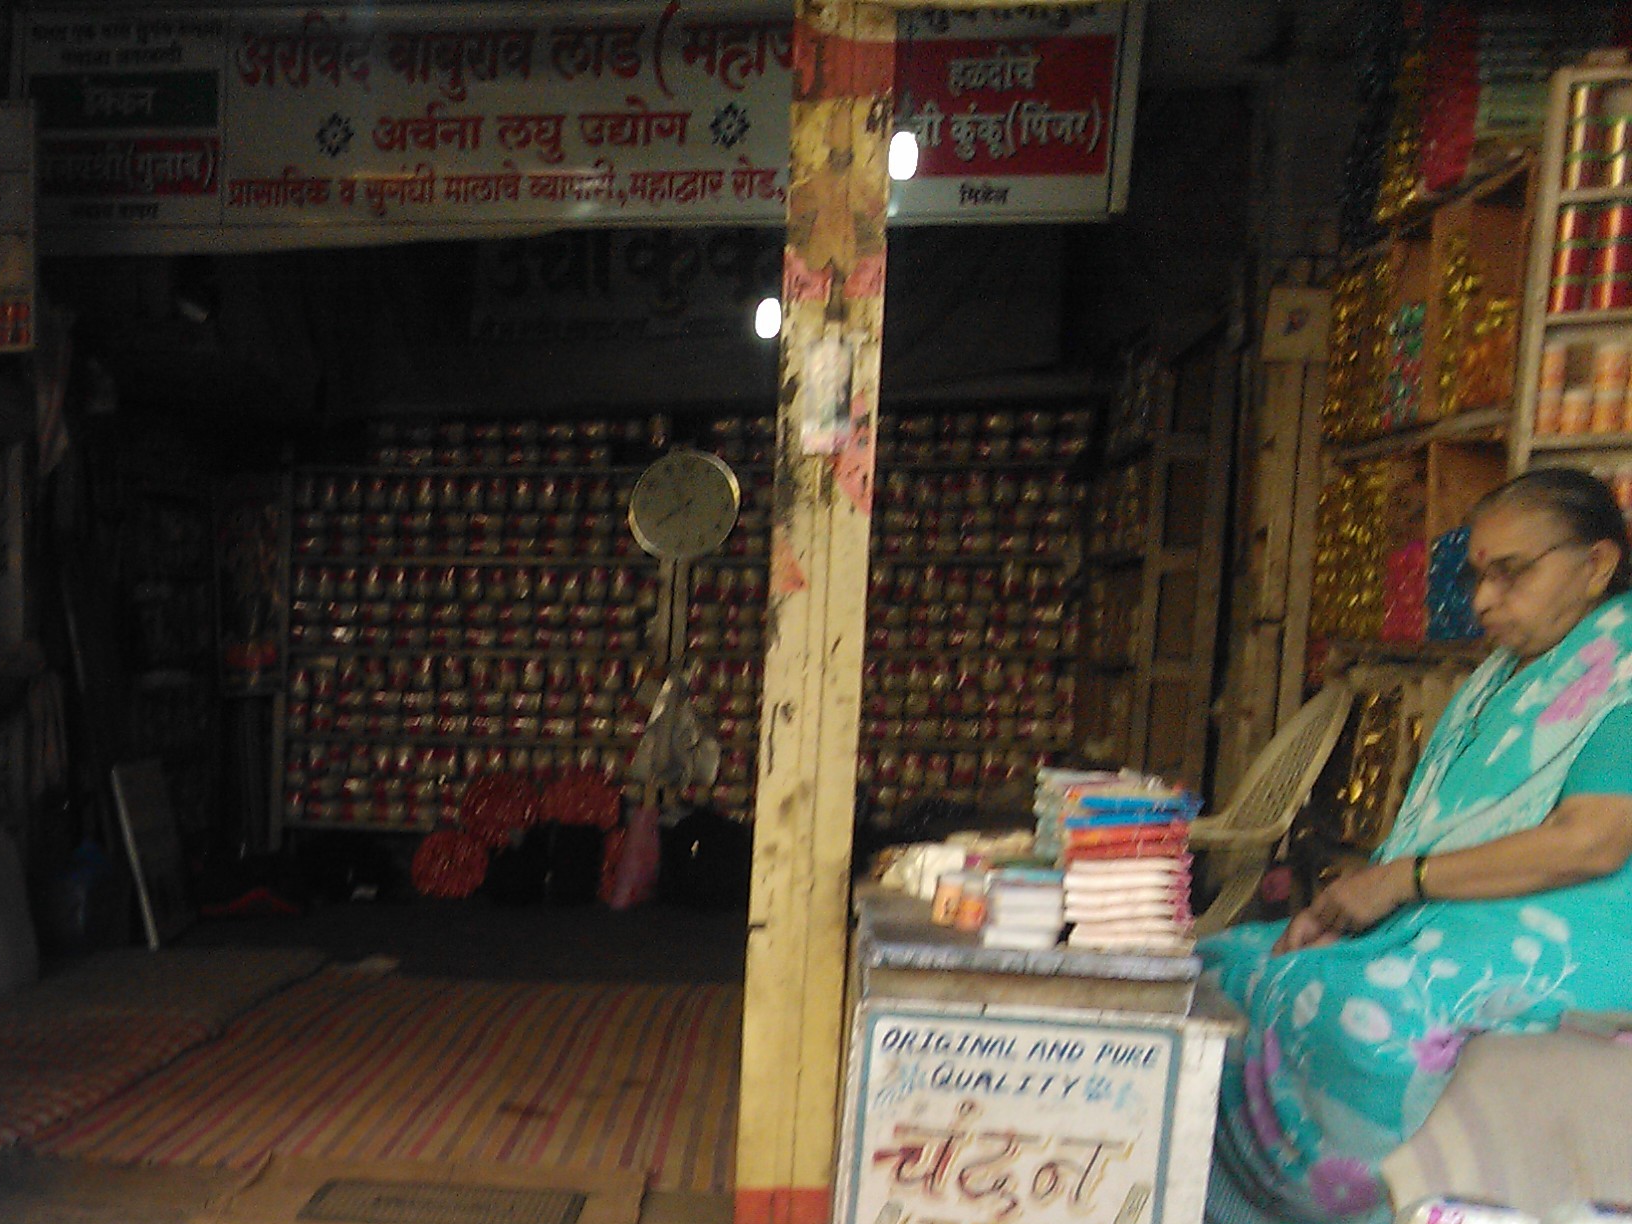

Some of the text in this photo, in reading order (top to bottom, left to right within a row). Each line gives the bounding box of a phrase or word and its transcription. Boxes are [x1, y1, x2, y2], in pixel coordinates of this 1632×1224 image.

[234, 11, 374, 92] अरविंद
[372, 95, 693, 164] अर्चना लघु उद्योग
[338, 179, 356, 207] व
[880, 1027, 1162, 1070] ORIGINAL AND PURE
[929, 1059, 1083, 1099] QUALITY
